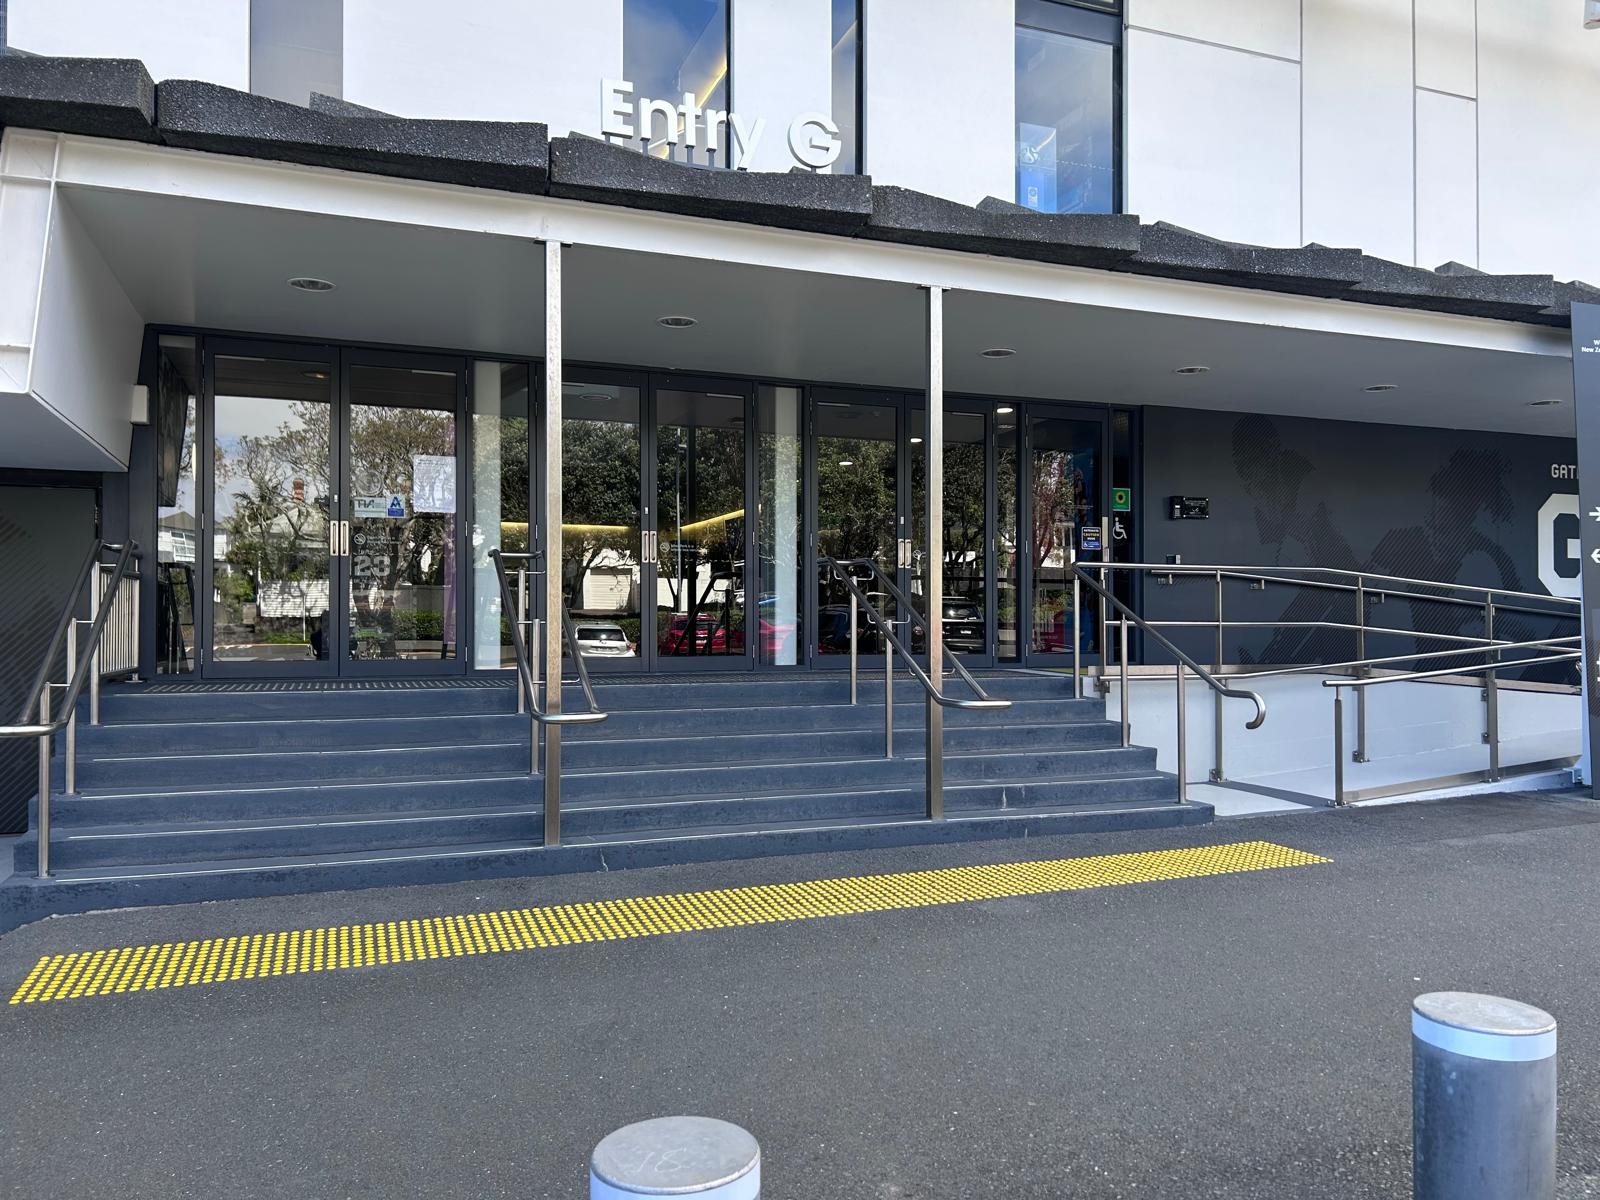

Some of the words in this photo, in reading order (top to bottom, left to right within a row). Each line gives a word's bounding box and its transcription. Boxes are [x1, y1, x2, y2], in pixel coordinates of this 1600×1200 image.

[601, 78, 766, 169] Entry
[788, 111, 842, 168] G
[1551, 463, 1579, 479] GAT
[1538, 493, 1581, 598] G
